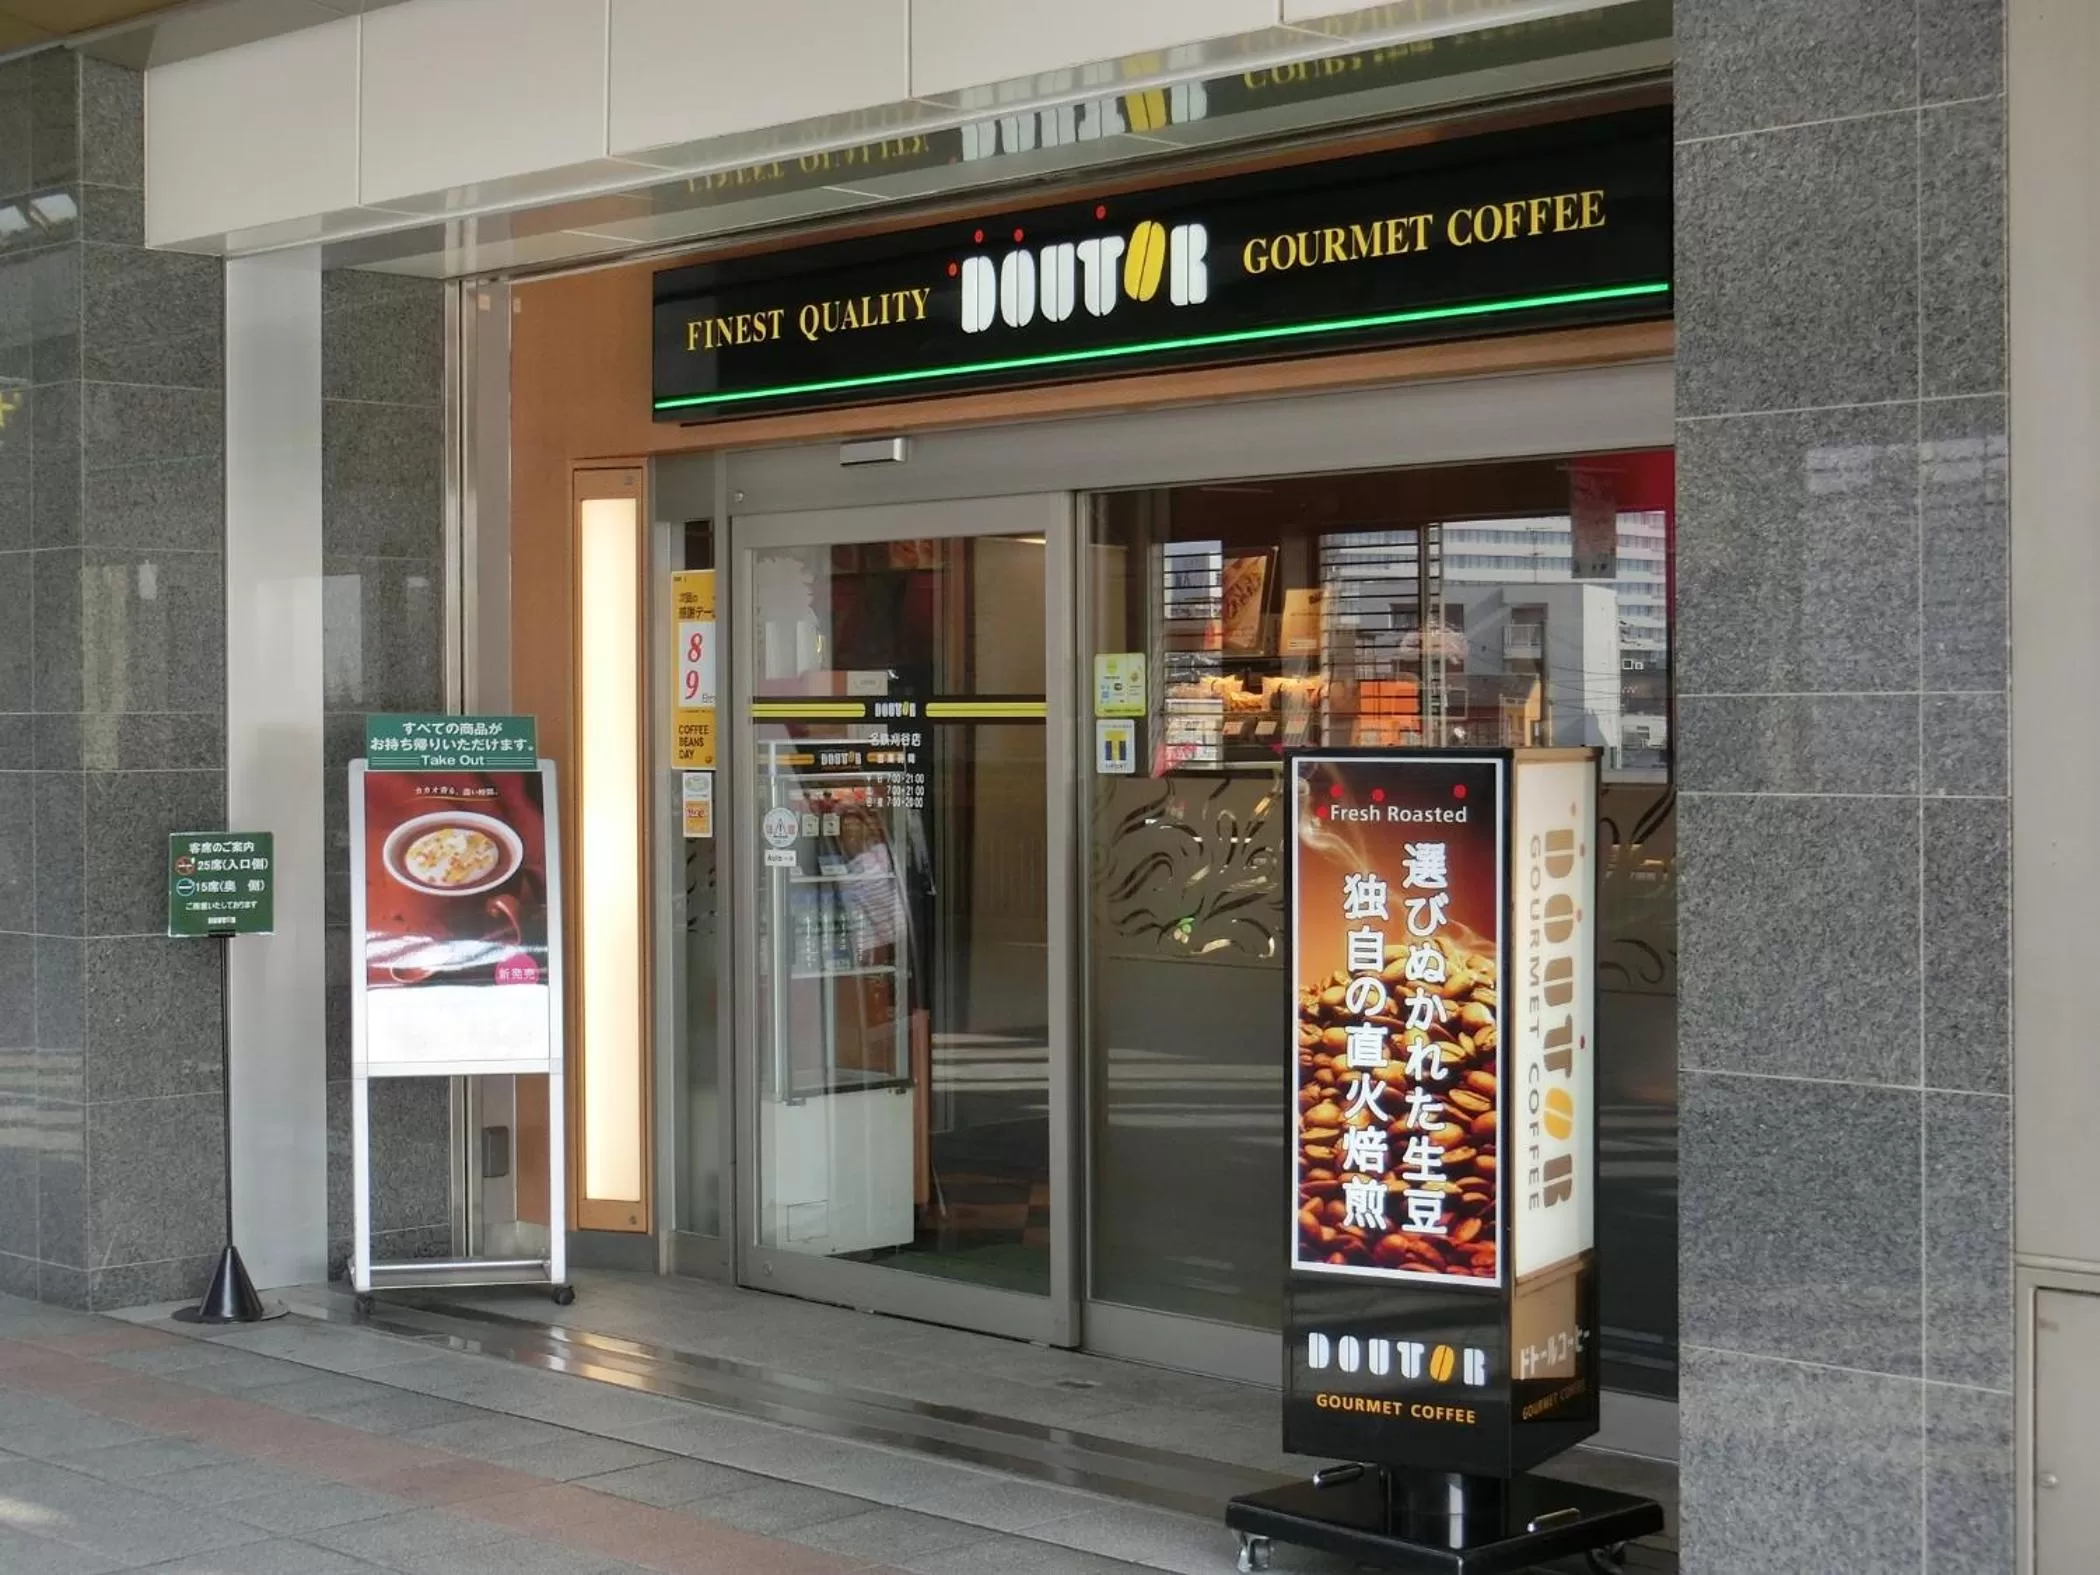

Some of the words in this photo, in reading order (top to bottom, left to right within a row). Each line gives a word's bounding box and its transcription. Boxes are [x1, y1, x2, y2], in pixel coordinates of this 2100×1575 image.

[1243, 214, 1433, 275] GOURMET
[1447, 190, 1605, 247] COFFEE
[961, 219, 1209, 334] DOUTOR
[687, 309, 784, 351] FINEST
[799, 288, 931, 338] QUALITY
[688, 632, 703, 663] 8
[685, 670, 699, 700] 9
[402, 722, 503, 735] すべての商品が
[678, 725, 709, 735] COFFEE
[678, 737, 704, 748] BEANS
[370, 738, 534, 751] お持ち帰りいただけます。
[421, 754, 455, 766] Take
[460, 755, 484, 766] Out
[678, 749, 694, 760] DAY
[1330, 805, 1381, 823] Fresh
[1387, 805, 1467, 824] Roasted
[189, 841, 255, 854] 客席のご案内
[1529, 833, 1542, 1039] GOURMET
[498, 967, 536, 981] 新発売
[1543, 828, 1575, 1209] DOUTOR
[1342, 873, 1390, 1232] 独自の直火焙煎
[1402, 841, 1450, 1235] 選びぬかれた生豆
[1528, 1061, 1541, 1211] COFFEE
[1307, 1332, 1488, 1387] DOUTOR
[1315, 1393, 1403, 1416] GOURMET
[1410, 1403, 1477, 1425] COFFEE
